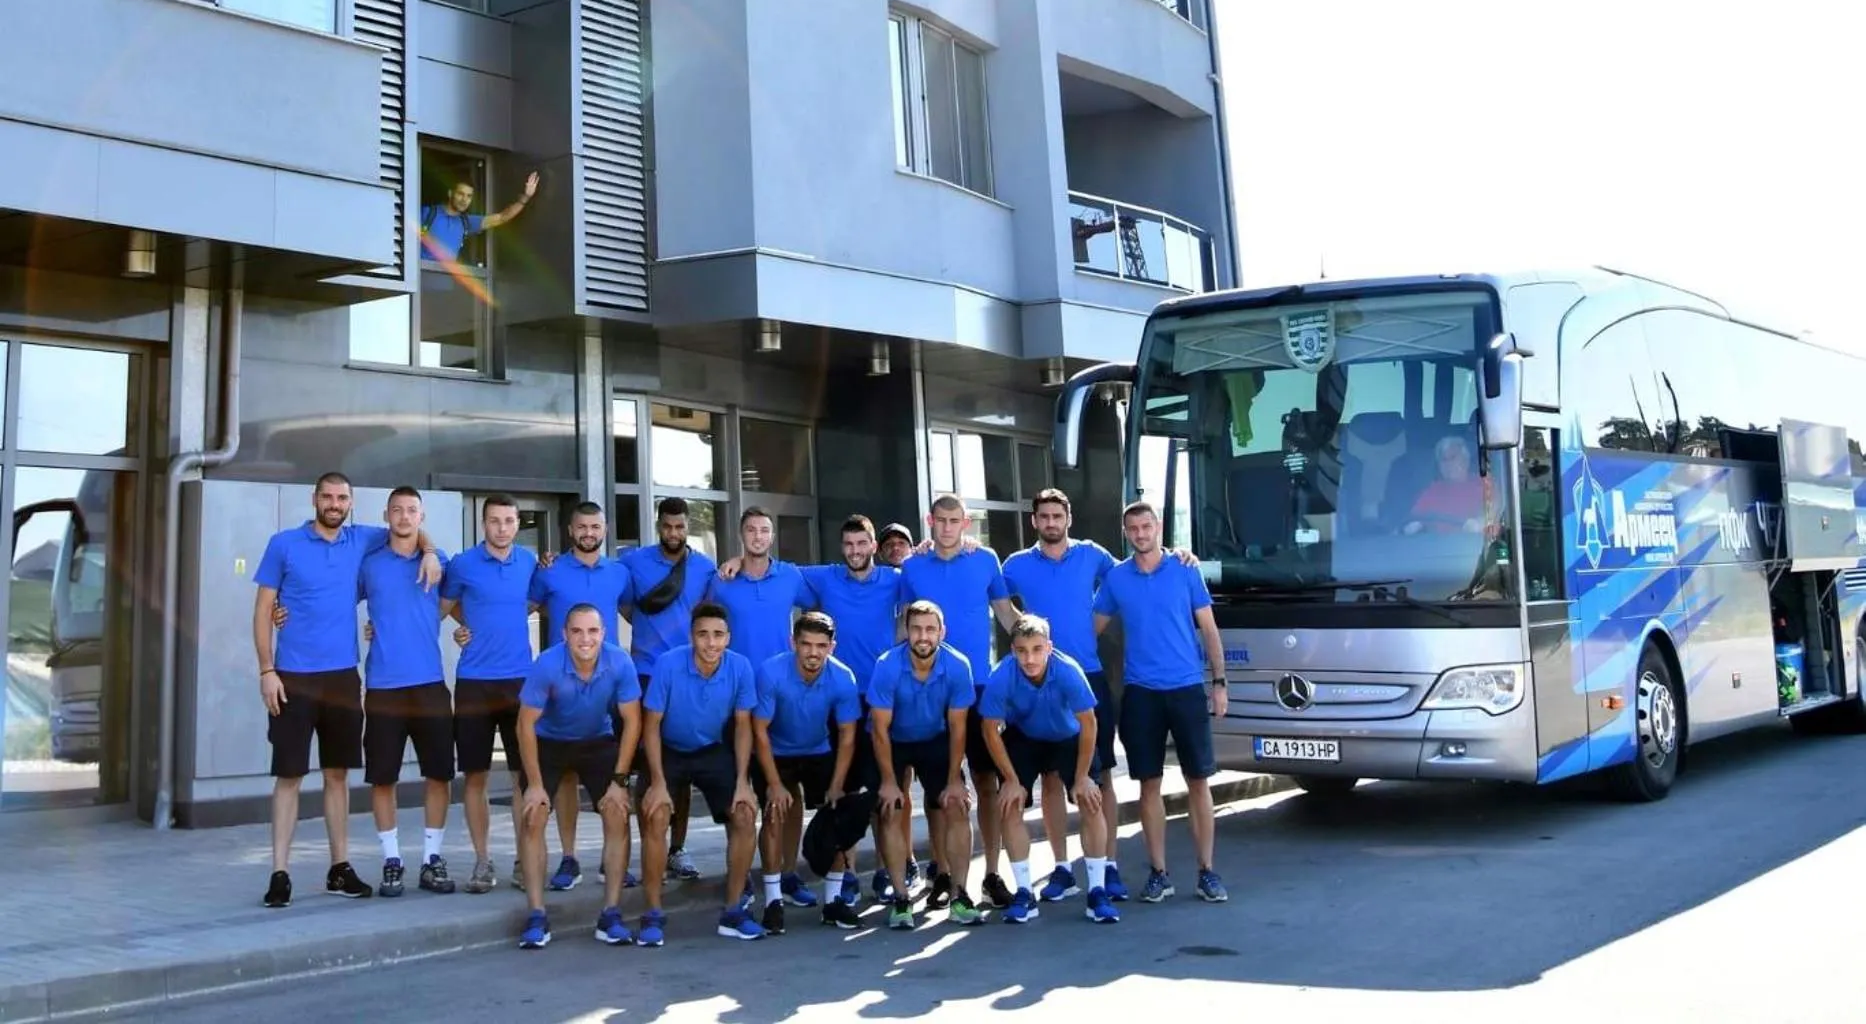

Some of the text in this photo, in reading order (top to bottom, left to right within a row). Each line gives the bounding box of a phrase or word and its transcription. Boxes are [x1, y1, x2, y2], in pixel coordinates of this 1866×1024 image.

[1263, 741, 1336, 758] CA 1913 HP
